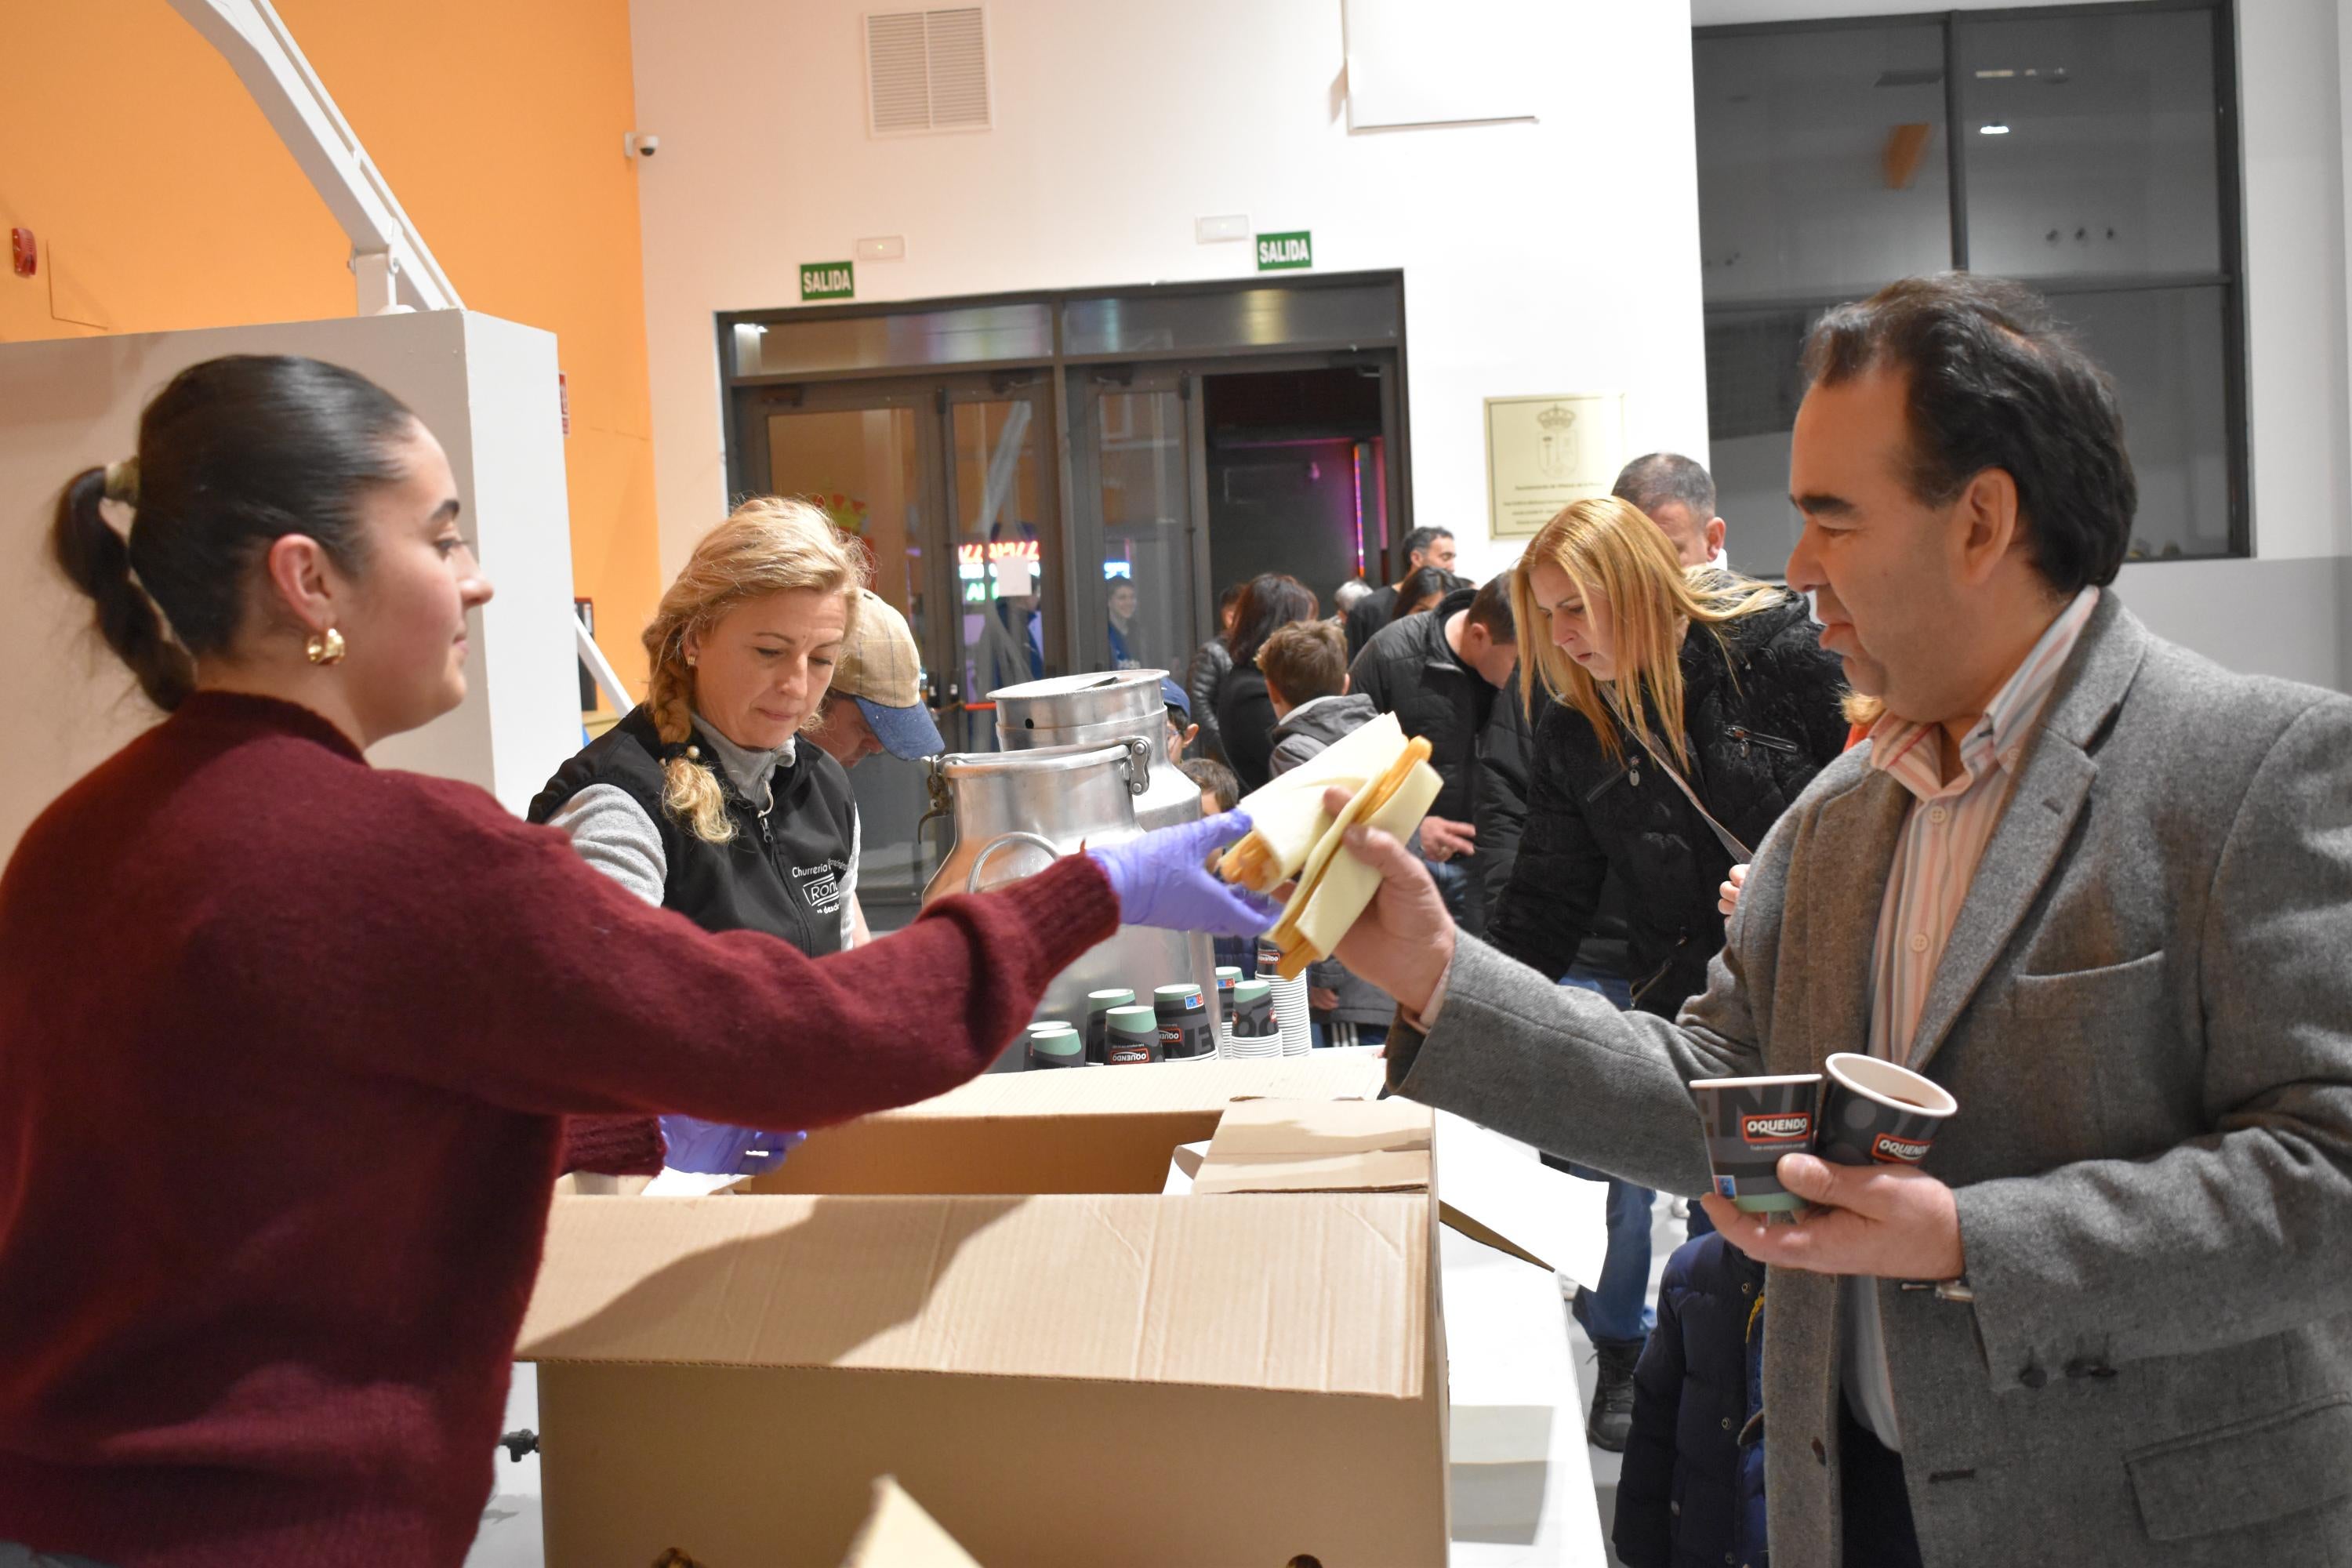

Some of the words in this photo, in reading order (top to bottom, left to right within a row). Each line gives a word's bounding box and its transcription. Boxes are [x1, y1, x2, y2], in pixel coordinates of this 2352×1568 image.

[1258, 237, 1311, 263] SALIDA
[803, 268, 852, 294] SALIDA
[1112, 1051, 1147, 1062] OQUENDO
[1747, 1117, 1807, 1136] OQUENDO
